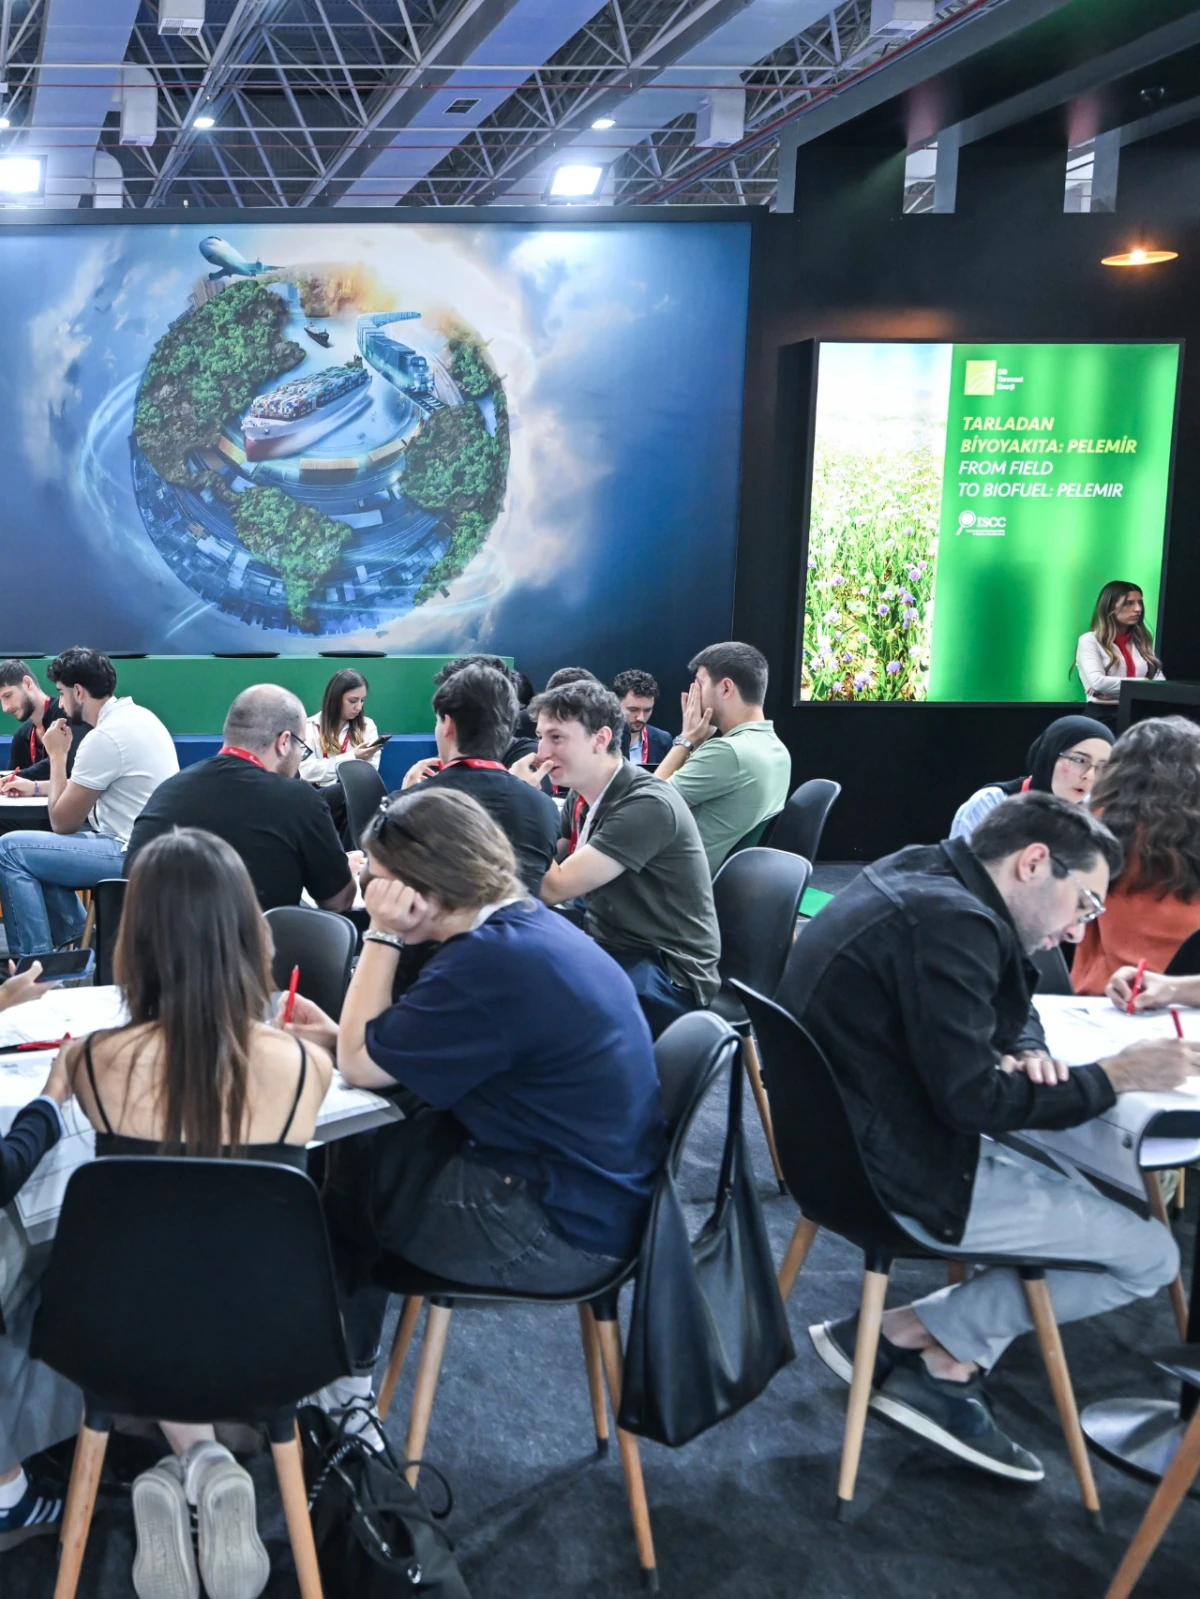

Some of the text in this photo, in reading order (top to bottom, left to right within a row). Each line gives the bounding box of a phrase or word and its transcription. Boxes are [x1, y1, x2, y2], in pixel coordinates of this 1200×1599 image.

[963, 417, 1055, 431] TARLADAN
[960, 434, 1137, 453] BİYOYAKITA: PELEMİR
[958, 460, 1054, 475] FROM FIELD
[958, 482, 1124, 498] TO BIOFUEL: PELEMIR
[977, 516, 1007, 528] ISCC
